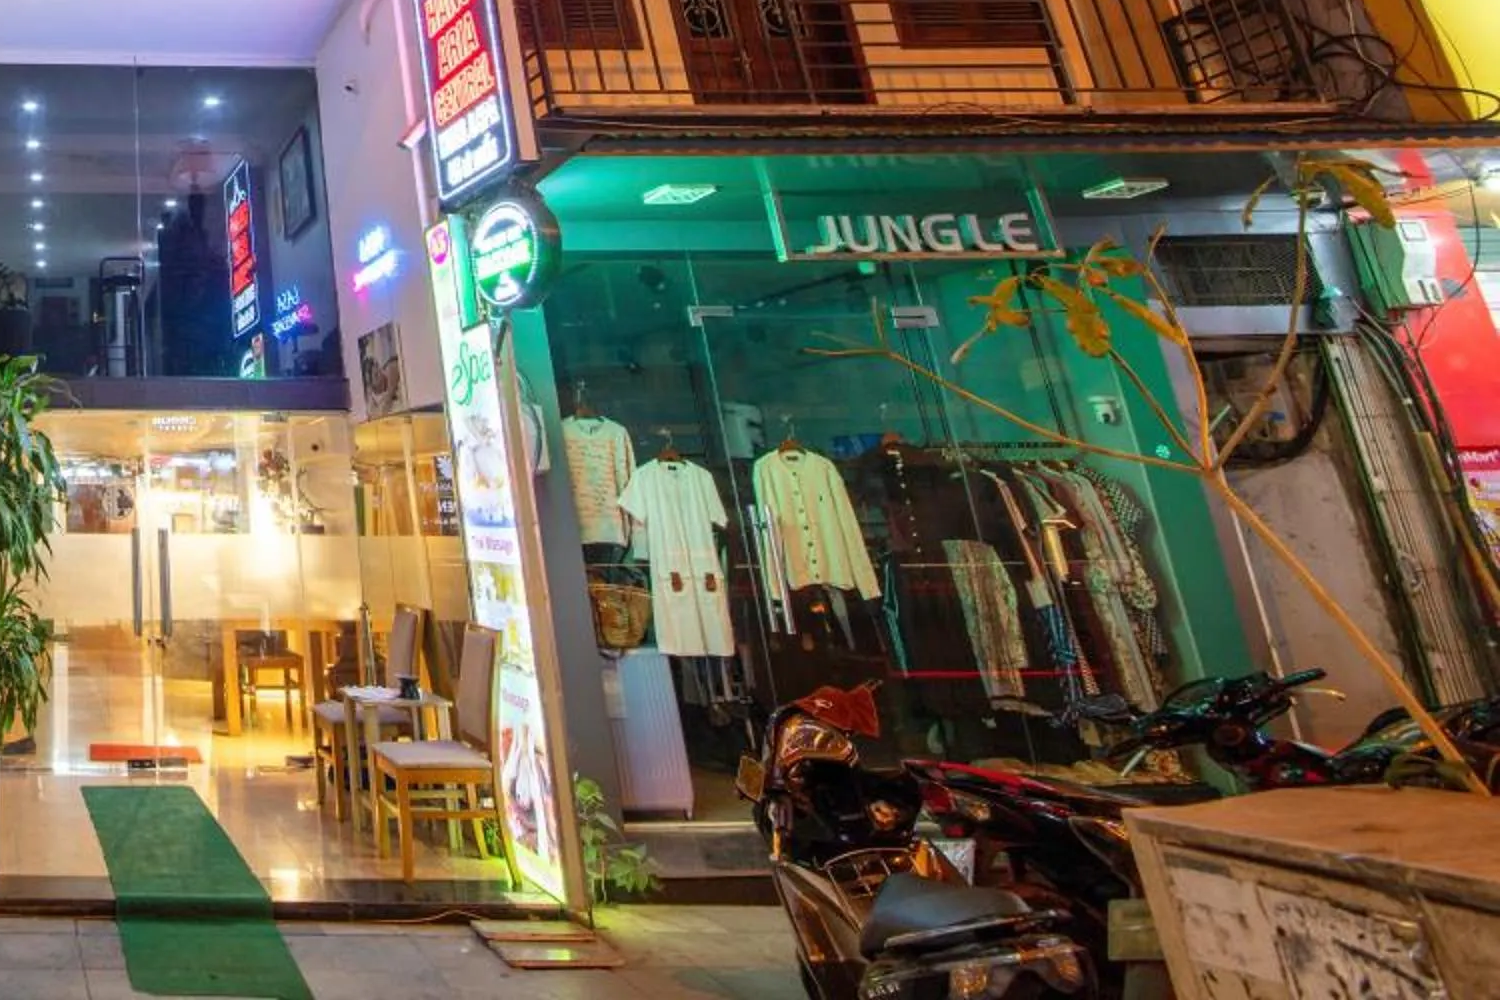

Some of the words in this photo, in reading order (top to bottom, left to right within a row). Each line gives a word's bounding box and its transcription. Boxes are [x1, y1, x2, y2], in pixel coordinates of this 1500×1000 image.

[437, 10, 480, 80] ARIA
[806, 212, 1038, 254] JUNGLE
[451, 341, 492, 406] Spa
